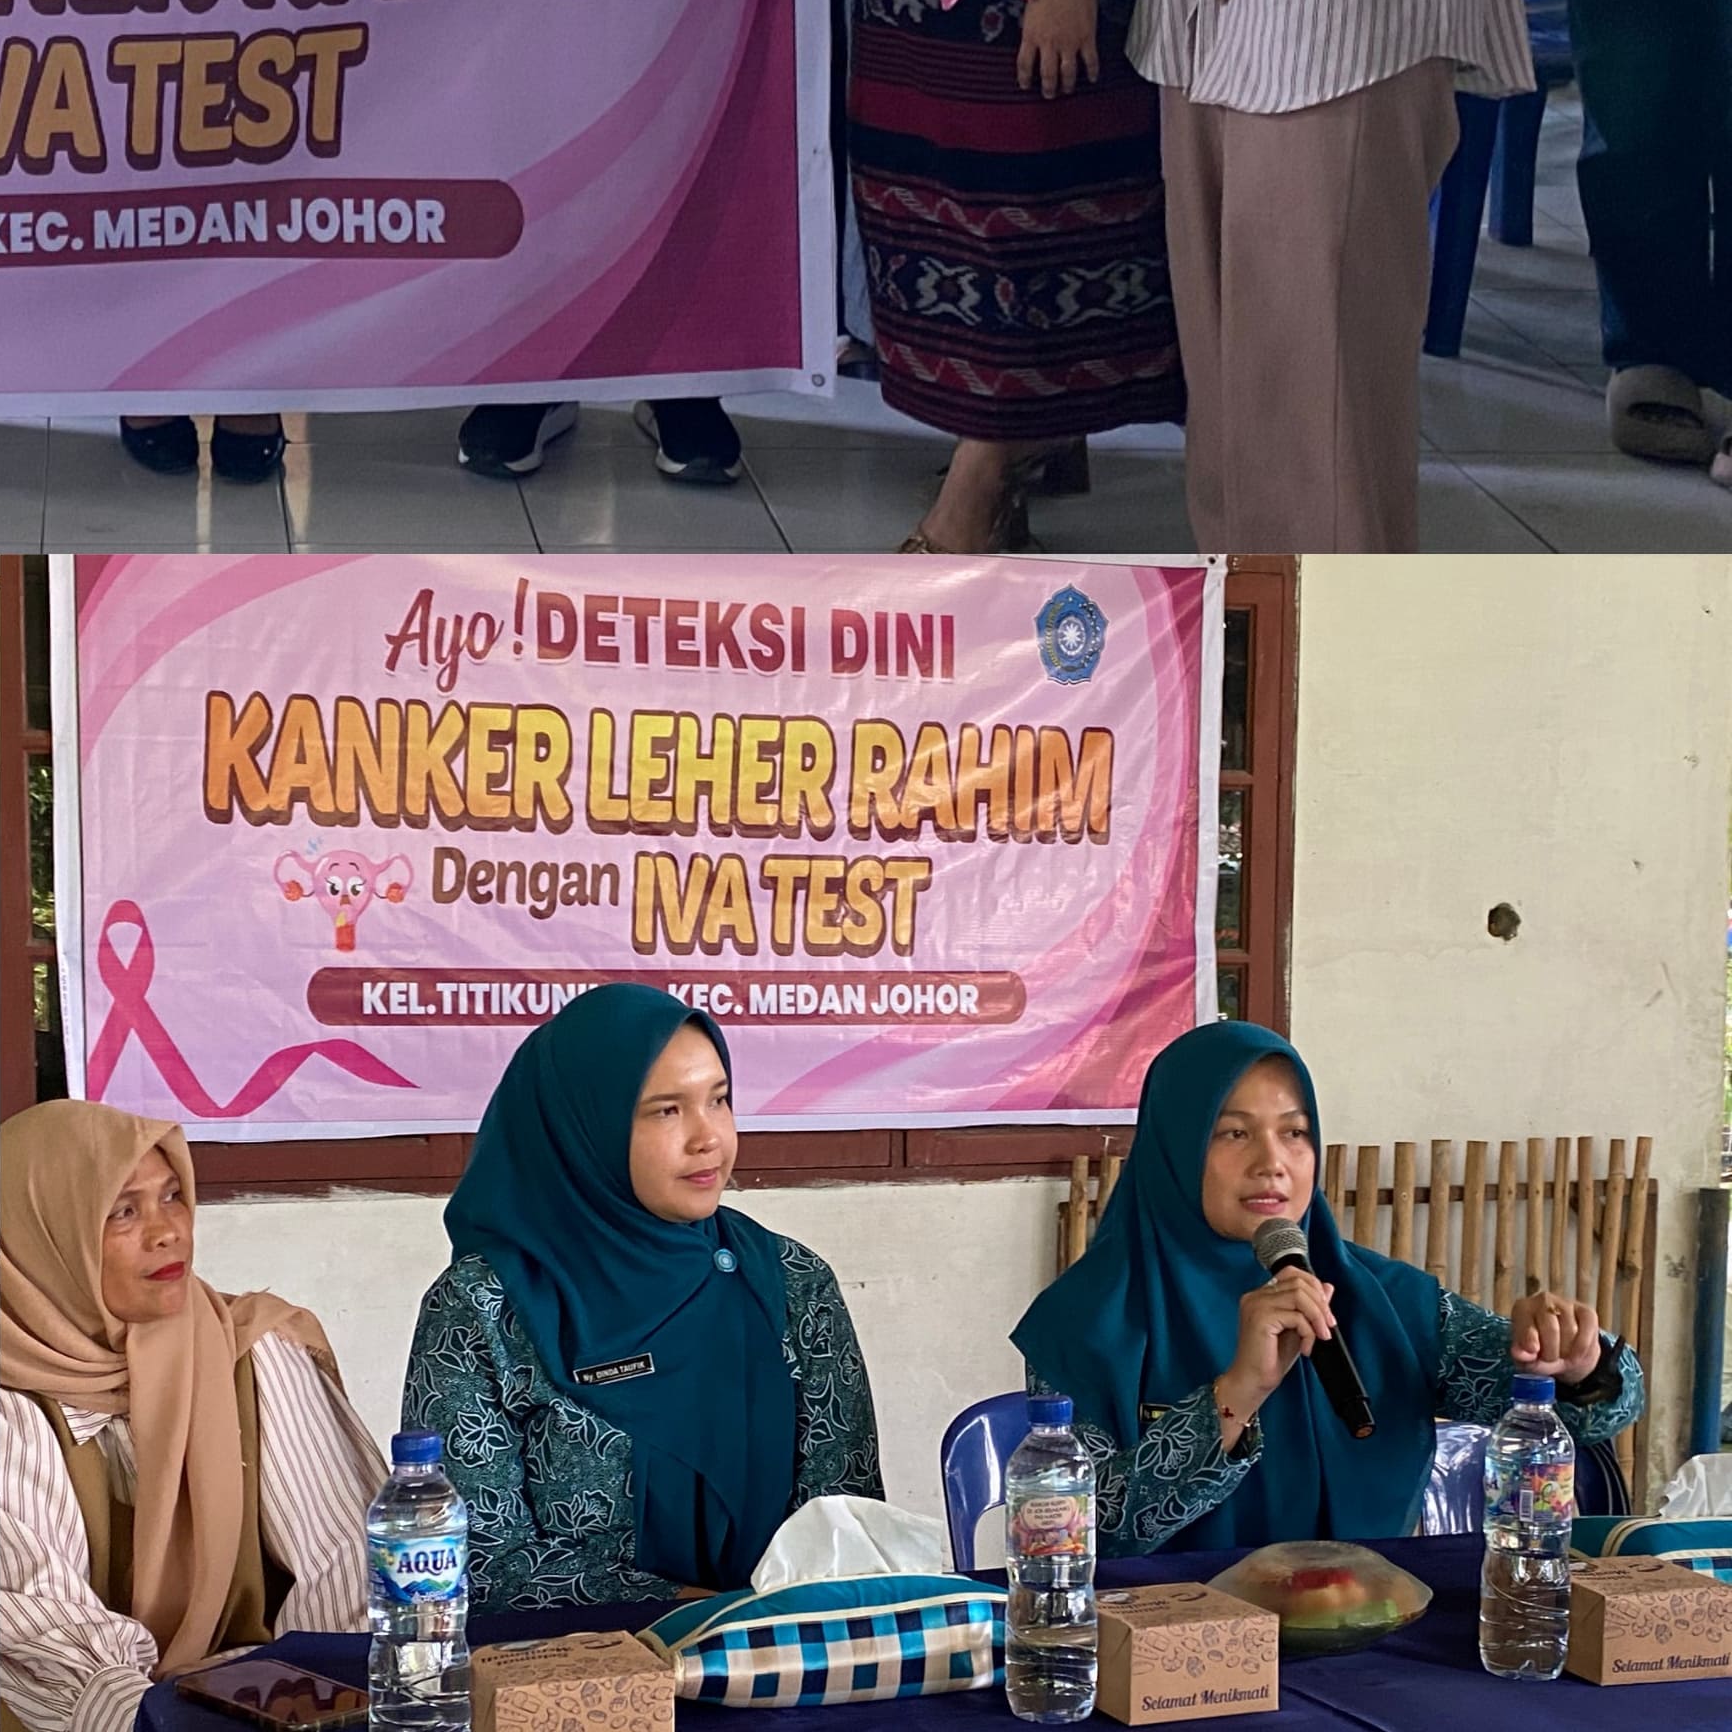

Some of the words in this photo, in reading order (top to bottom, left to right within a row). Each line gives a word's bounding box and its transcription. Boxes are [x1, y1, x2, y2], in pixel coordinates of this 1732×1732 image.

[106, 22, 372, 170] TEST
[93, 199, 268, 252] MEDAN
[276, 195, 448, 246] JOHOR
[384, 577, 529, 694] Ayo!
[536, 591, 806, 674] DETEKSI
[829, 608, 955, 680] DINI
[203, 690, 573, 835] KANKER
[585, 707, 836, 842] LEHER
[848, 718, 1115, 845] RAHIM
[431, 846, 620, 920] Dengan
[631, 851, 759, 957] IVA
[759, 853, 934, 958] TEST
[362, 982, 599, 1016] KEL.TITIKUN
[749, 983, 867, 1015] MEDAN
[870, 983, 980, 1015] JOHOR
[396, 1547, 458, 1576] AQUA
[1612, 1658, 1664, 1674] Selamat
[1666, 1651, 1732, 1670] Menikmati
[1141, 1692, 1198, 1711] Selamat
[1199, 1683, 1270, 1706] Menikmati
